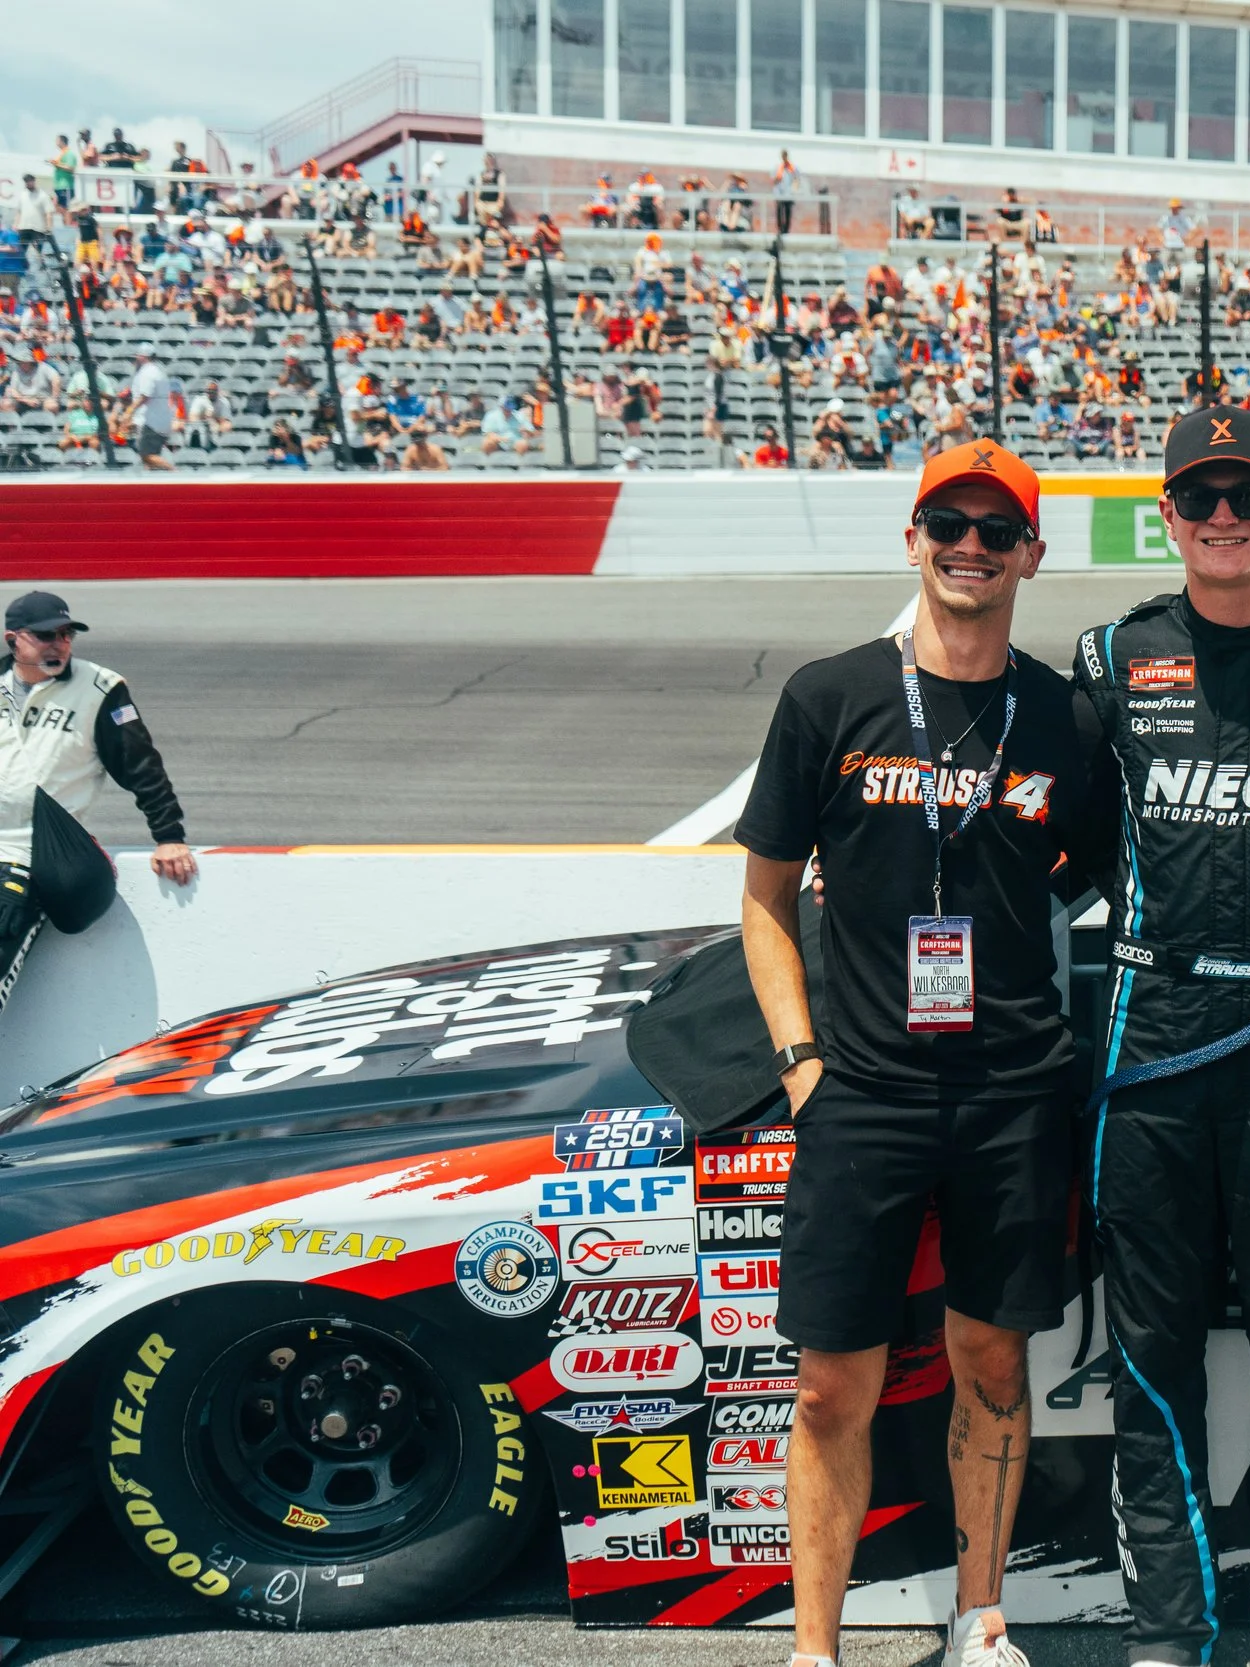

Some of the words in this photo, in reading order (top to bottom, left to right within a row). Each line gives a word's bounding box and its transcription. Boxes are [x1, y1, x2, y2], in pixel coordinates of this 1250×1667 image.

[96, 178, 116, 200] B
[1131, 668, 1192, 681] CRAFTSMAN
[904, 678, 926, 730] NASCAR
[1127, 696, 1197, 711] GOODYEAR
[1155, 719, 1195, 727] SOLUTIONS
[1161, 726, 1195, 734] STAFFING
[839, 751, 918, 776] Donova
[921, 775, 940, 830] NASCAR
[959, 779, 993, 830] NASCAR
[1000, 770, 1056, 823] 4
[920, 941, 960, 949] CRAFTSMAN
[1112, 941, 1154, 966] sparco
[932, 965, 950, 976] NORTH
[913, 975, 970, 993] WILKESBORO
[584, 1121, 655, 1151] 250
[702, 1151, 797, 1175] CRAFTS
[538, 1175, 687, 1218] SKF
[742, 1184, 774, 1195] TRUCK
[699, 1207, 785, 1241] Holle
[466, 1226, 545, 1256] CHAMPION
[468, 1279, 549, 1311] IRRIGATION
[570, 1286, 677, 1322] KLOTZ
[626, 1319, 668, 1328] LUBRICANTS
[704, 1343, 800, 1381] JES
[726, 1381, 762, 1391] SHAFT
[767, 1380, 798, 1390] ROCK
[573, 1404, 619, 1419] FIVE
[624, 1401, 672, 1415] STAR
[725, 1426, 782, 1434] GASKET
[478, 1381, 526, 1518] EAGLE
[711, 1438, 788, 1467] CAL
[602, 1490, 691, 1506] KENNAMETAL
[712, 1486, 788, 1512] KOO
[290, 1512, 321, 1527] AERO
[717, 1526, 791, 1544] LINCO
